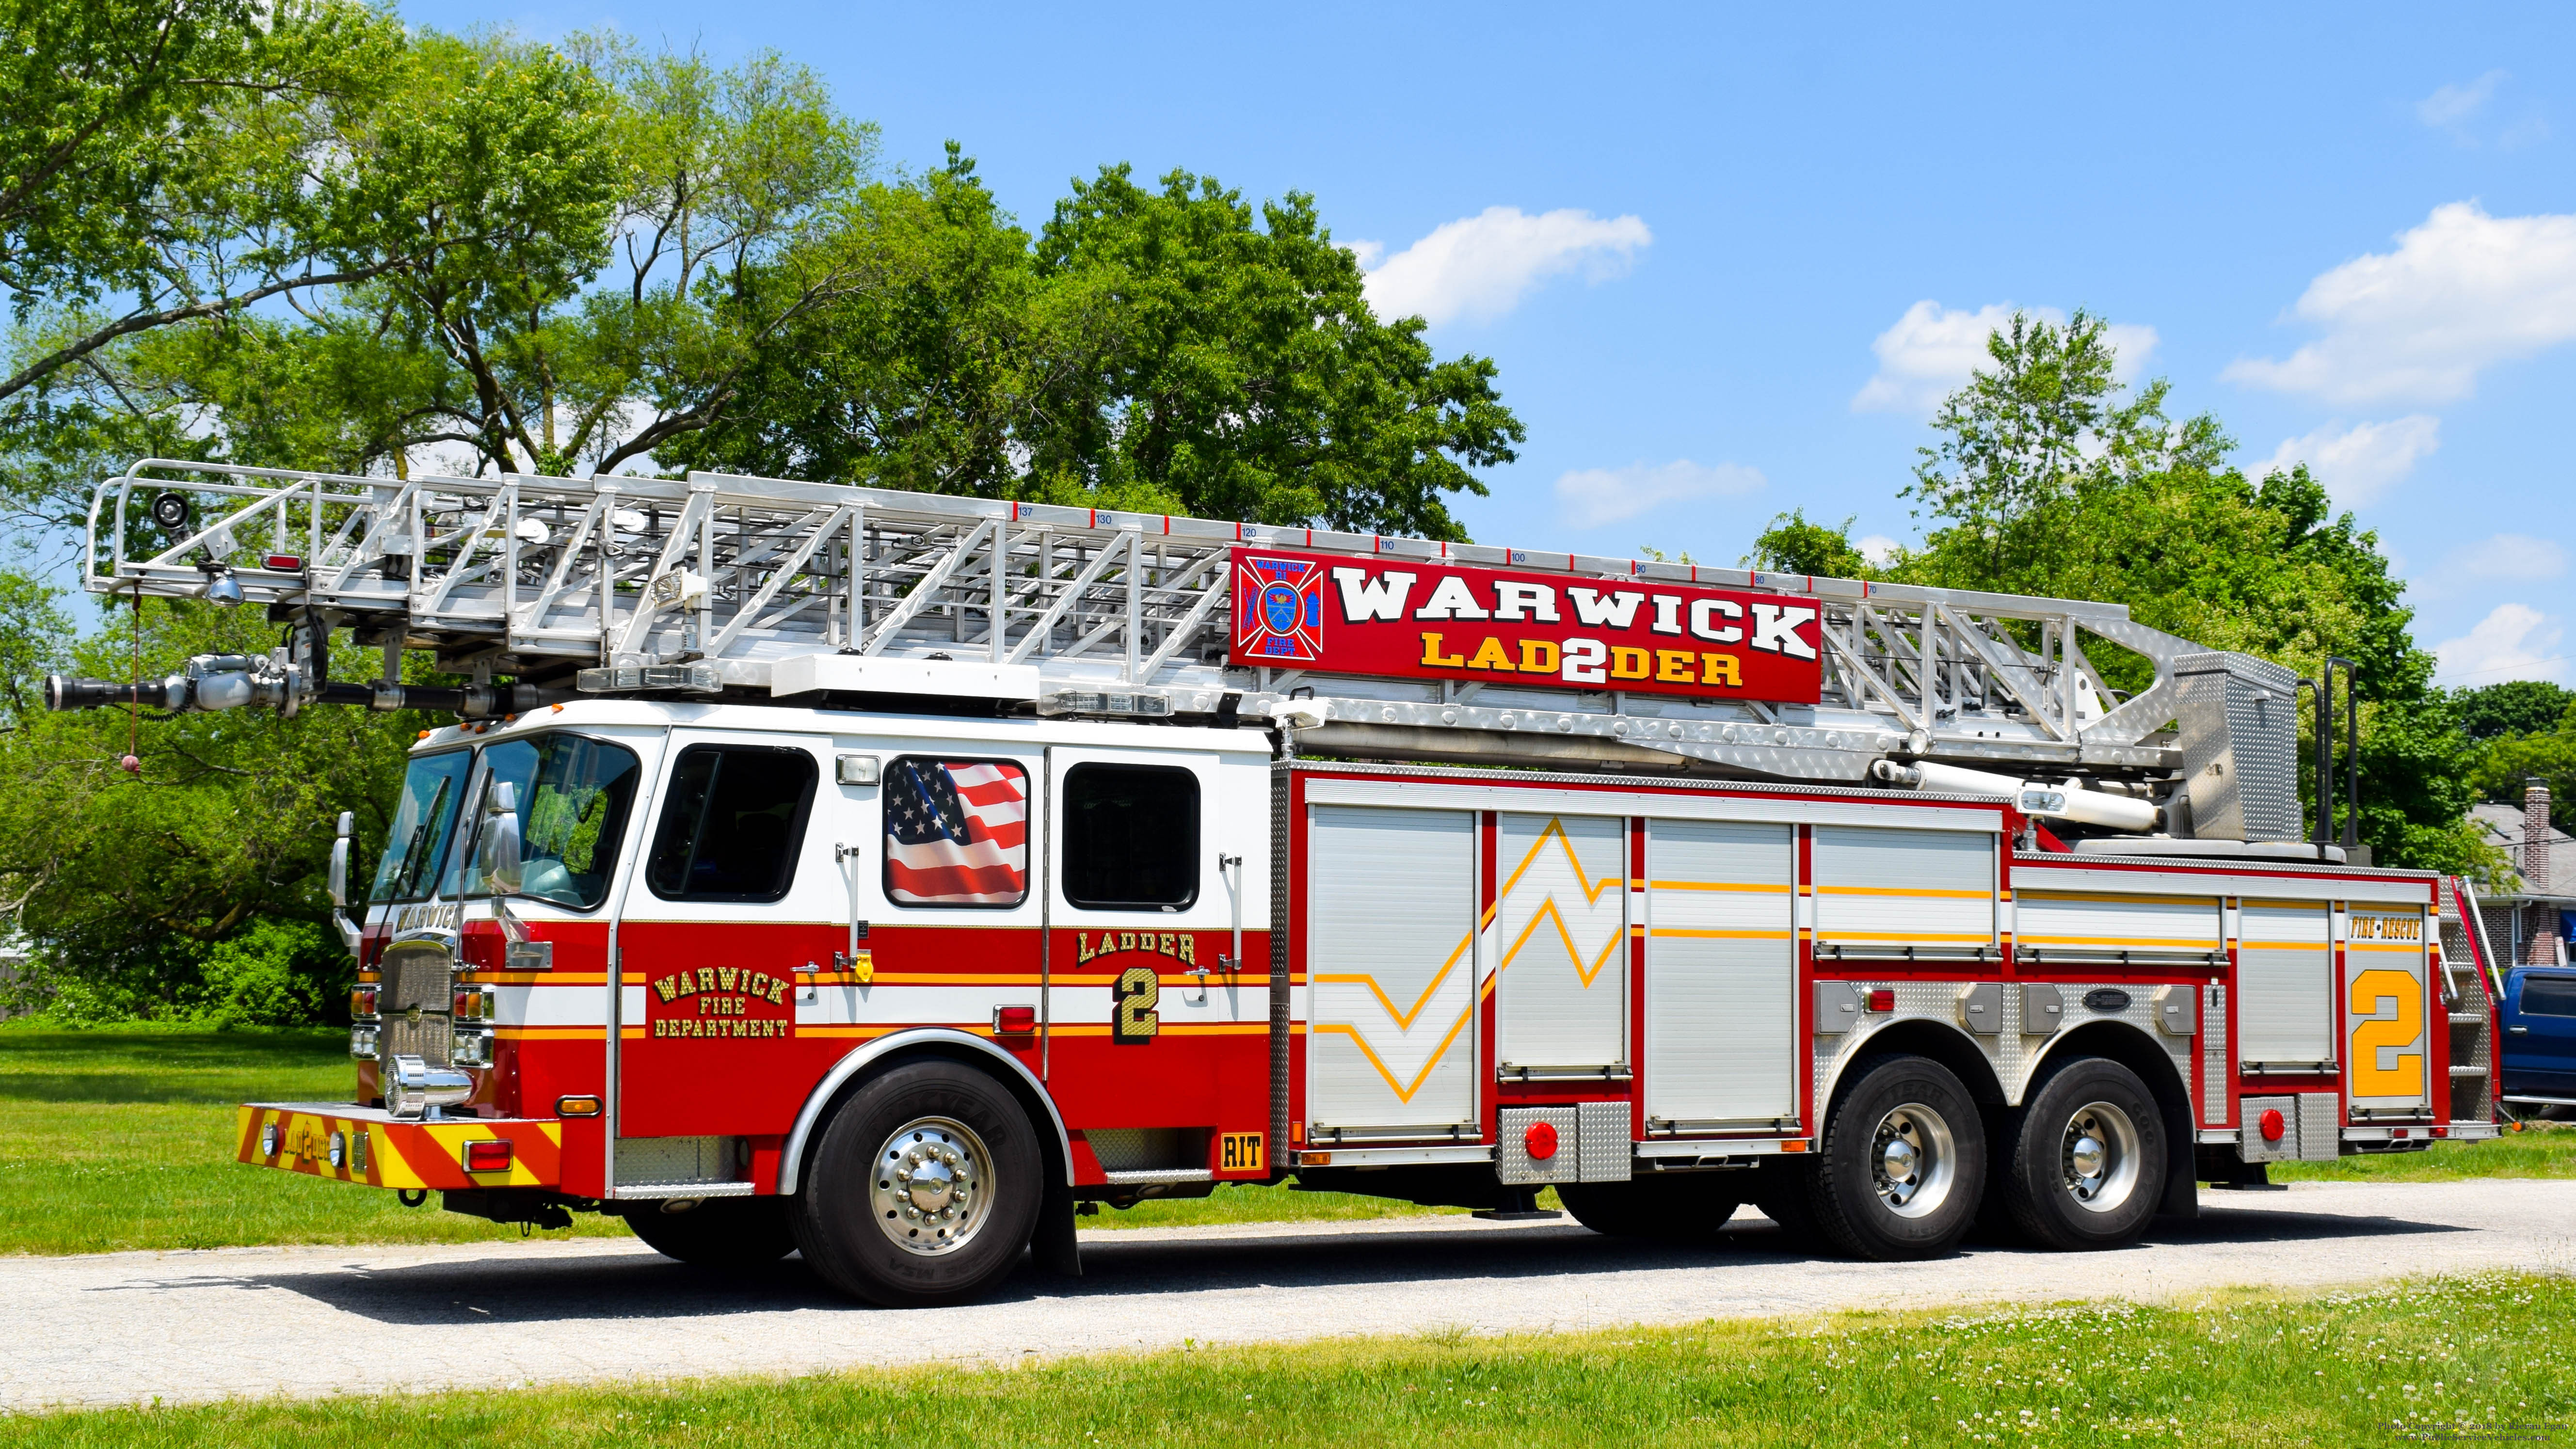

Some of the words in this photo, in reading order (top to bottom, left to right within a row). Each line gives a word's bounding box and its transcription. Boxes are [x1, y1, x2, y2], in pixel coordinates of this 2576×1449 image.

[1018, 507, 1033, 517] 137
[1096, 514, 1112, 525] 130
[1242, 527, 1257, 537] 120
[1381, 541, 1394, 551] 110
[1511, 553, 1526, 563] 100
[1256, 560, 1306, 573] WARWICK
[1636, 564, 1646, 574] 90
[1276, 571, 1287, 580] RI
[1755, 575, 1765, 585] 80
[1868, 585, 1877, 594] 70
[1329, 566, 1816, 661] WARWICK
[1267, 637, 1295, 647] FIRE
[1265, 646, 1298, 656] DEPT.
[396, 904, 466, 933] WARWICK
[2382, 918, 2420, 940] RESCUE
[1077, 932, 1195, 967] LADDER
[653, 967, 790, 1005] WARWICK
[699, 997, 745, 1015] FIRE
[1112, 967, 1159, 1044] 2
[653, 1019, 787, 1038] DEPARTMENT
[2351, 970, 2422, 1097] 2
[1224, 1136, 1262, 1168] RIT
